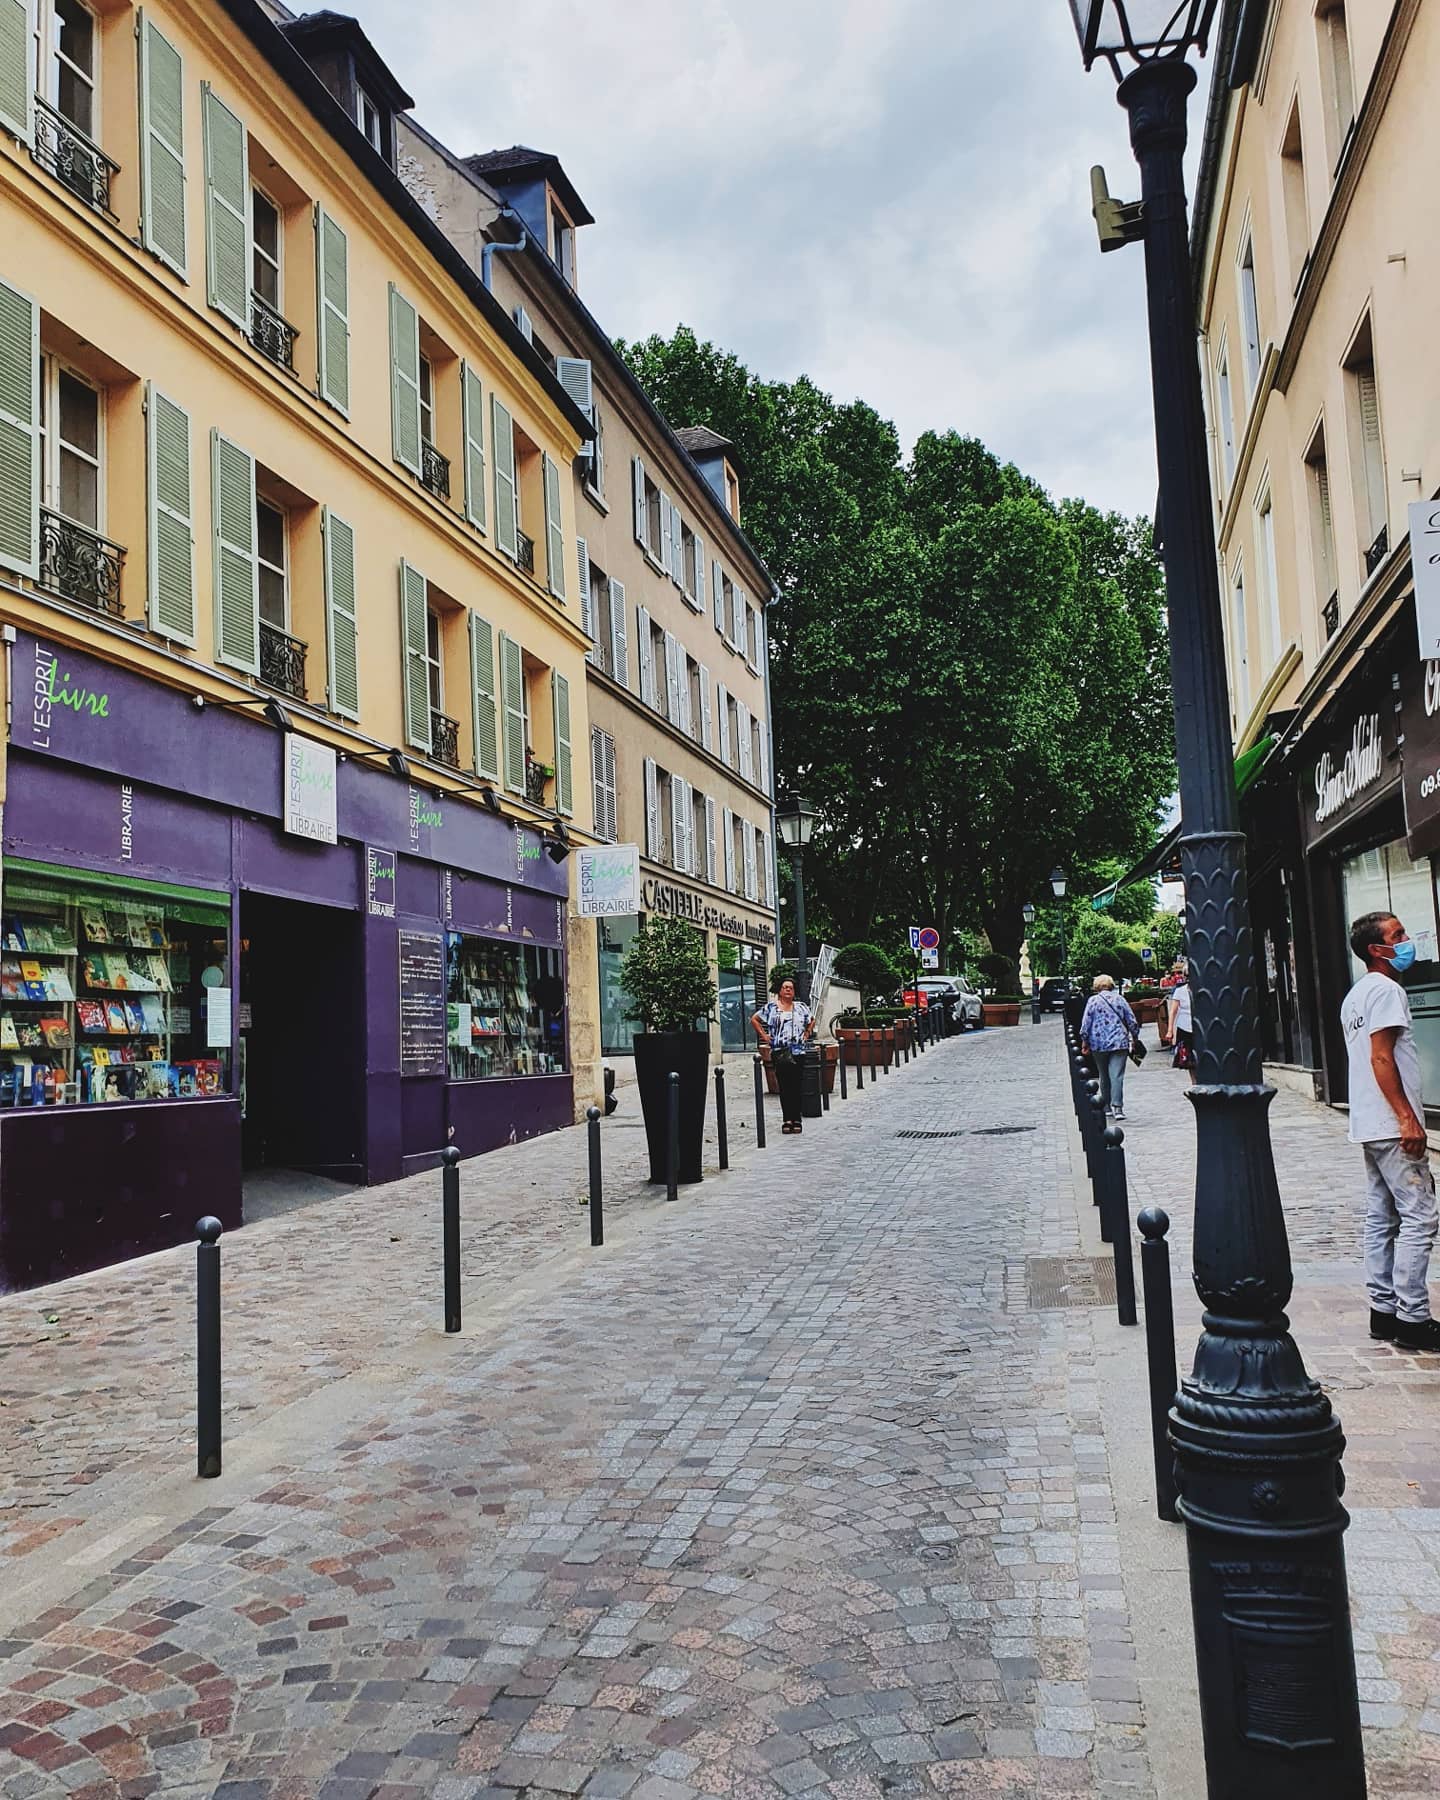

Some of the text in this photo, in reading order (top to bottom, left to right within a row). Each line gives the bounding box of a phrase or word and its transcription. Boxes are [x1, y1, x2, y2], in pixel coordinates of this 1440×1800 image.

[33, 642, 53, 748] L'ESPRIT
[49, 658, 109, 717] Livre
[290, 740, 302, 817] L'ESPRIT
[121, 783, 133, 859] LIBRAIRIE
[289, 815, 333, 841] LIBRAIRIE
[408, 784, 420, 853] L'ESPRIT
[416, 793, 443, 828] Livre
[368, 847, 377, 902] L'ESPRIT
[514, 825, 525, 882] L'ESPRIT
[581, 853, 594, 902] L'ESPRIT
[591, 855, 634, 879] Livre
[368, 902, 396, 918] LIBRAIRIE
[582, 899, 635, 914] LIBRAIRIE
